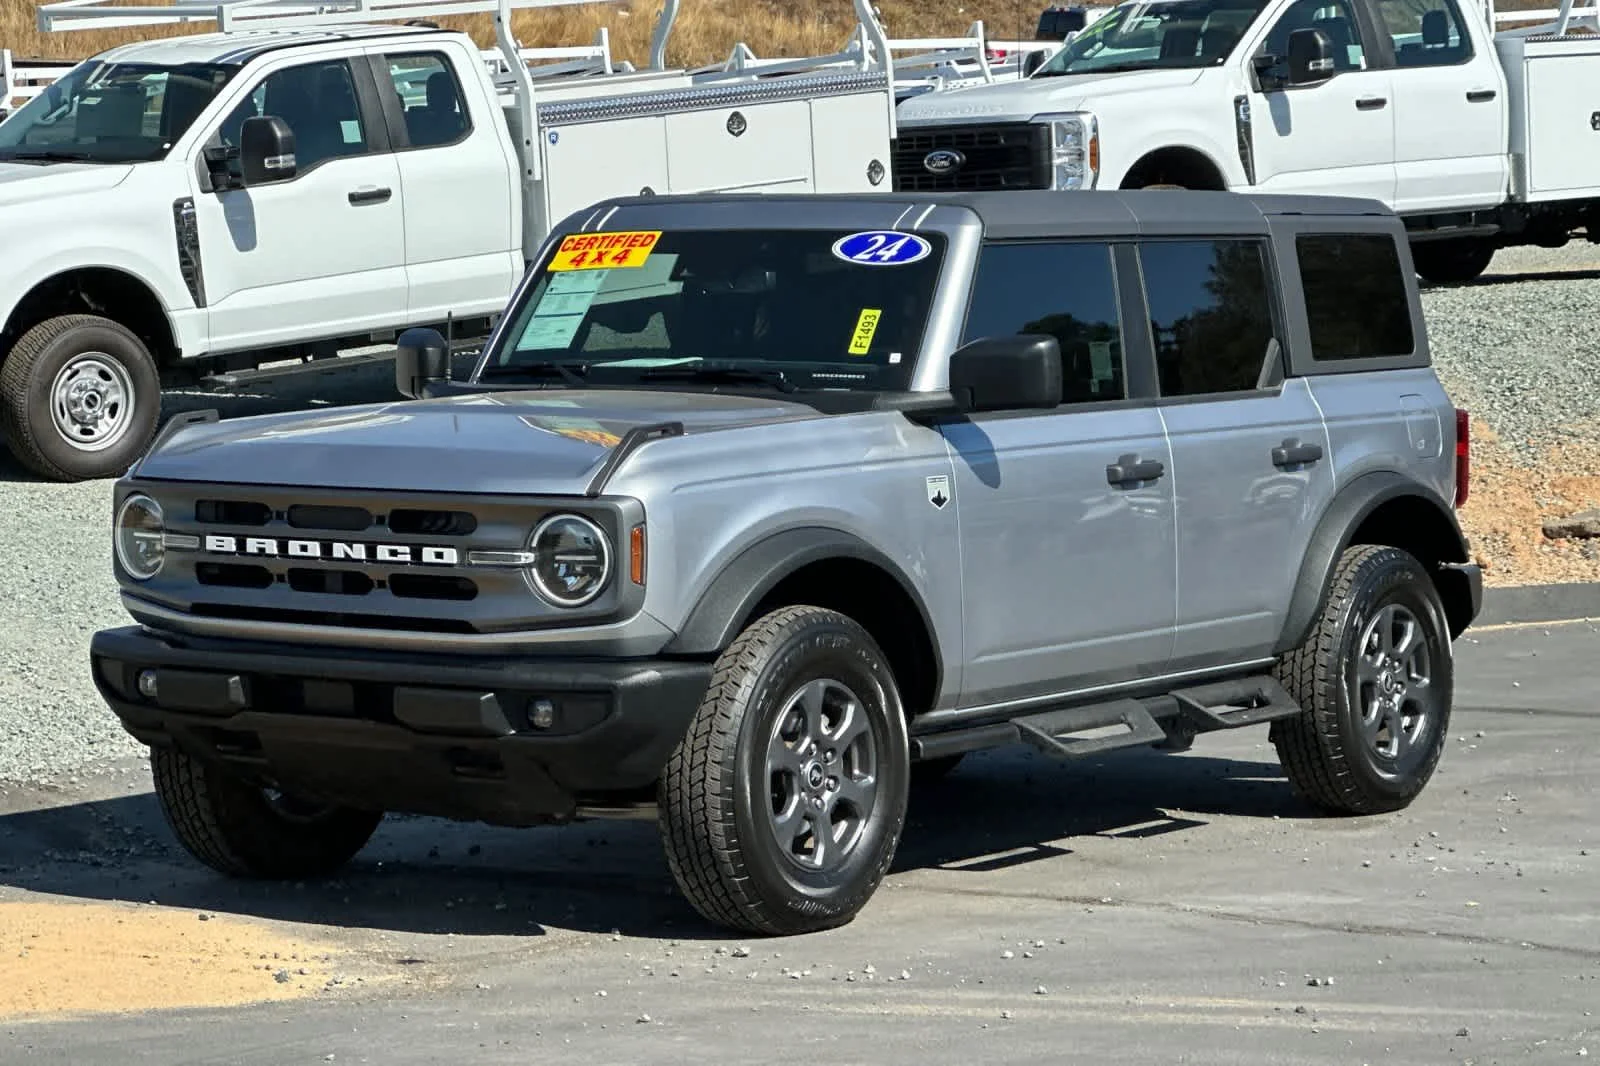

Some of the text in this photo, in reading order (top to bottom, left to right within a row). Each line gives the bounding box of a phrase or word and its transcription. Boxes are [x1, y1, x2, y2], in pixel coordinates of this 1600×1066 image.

[561, 233, 656, 252] CERTIFIED
[852, 234, 910, 262] 24
[854, 313, 877, 349] F1493
[205, 535, 458, 564] BRONCO
